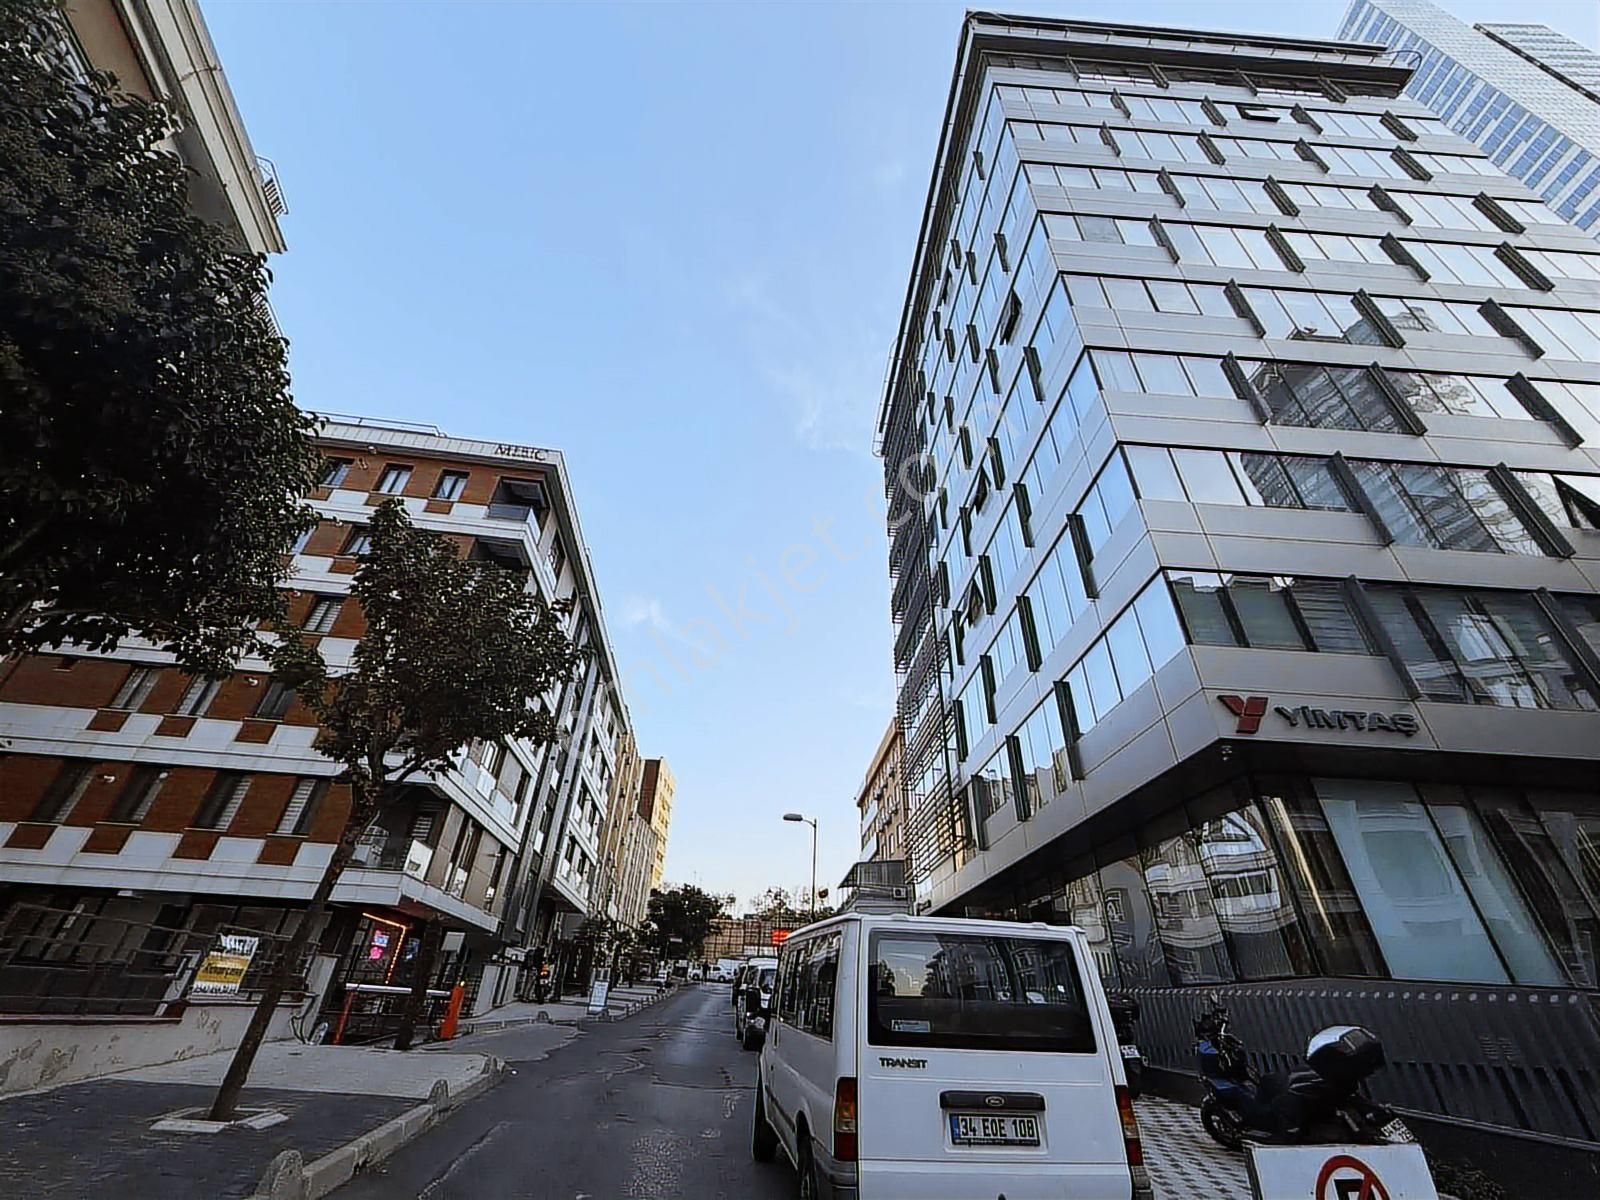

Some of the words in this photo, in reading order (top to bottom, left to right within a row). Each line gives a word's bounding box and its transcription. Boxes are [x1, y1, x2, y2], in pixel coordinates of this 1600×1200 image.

[1274, 706, 1420, 736] YİMTAŞ
[879, 1057, 928, 1069] TRANSIT
[960, 1117, 977, 1137] 34
[1012, 1118, 1035, 1138] 108
